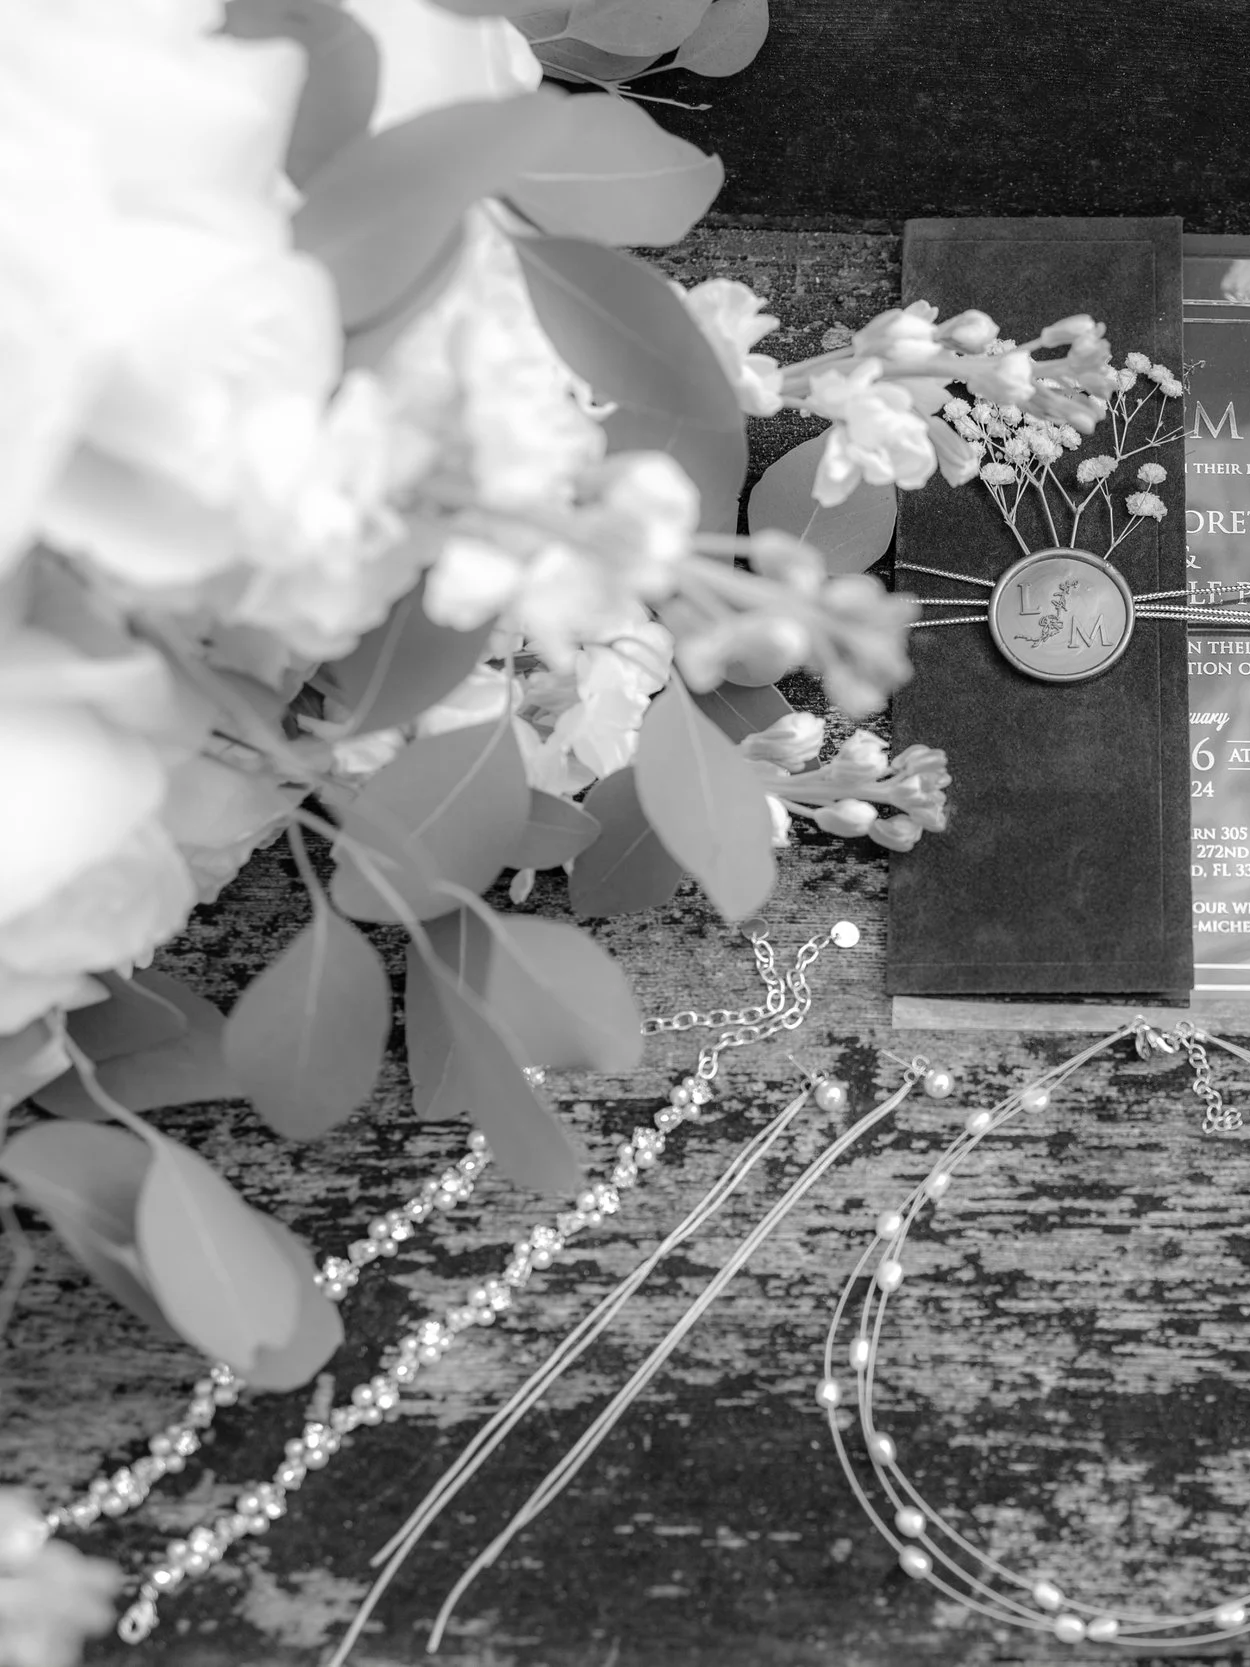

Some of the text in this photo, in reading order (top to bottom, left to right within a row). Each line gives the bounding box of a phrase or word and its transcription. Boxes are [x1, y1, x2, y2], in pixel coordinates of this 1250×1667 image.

[1189, 400, 1244, 440] M
[1193, 462, 1243, 475] THEIR
[1017, 583, 1041, 616] L
[1067, 613, 1114, 649] M
[1191, 736, 1216, 771] 6
[1190, 780, 1216, 798] 24
[1220, 826, 1249, 841] 305
[1196, 845, 1250, 859] 272ND
[1212, 863, 1232, 877] FL
